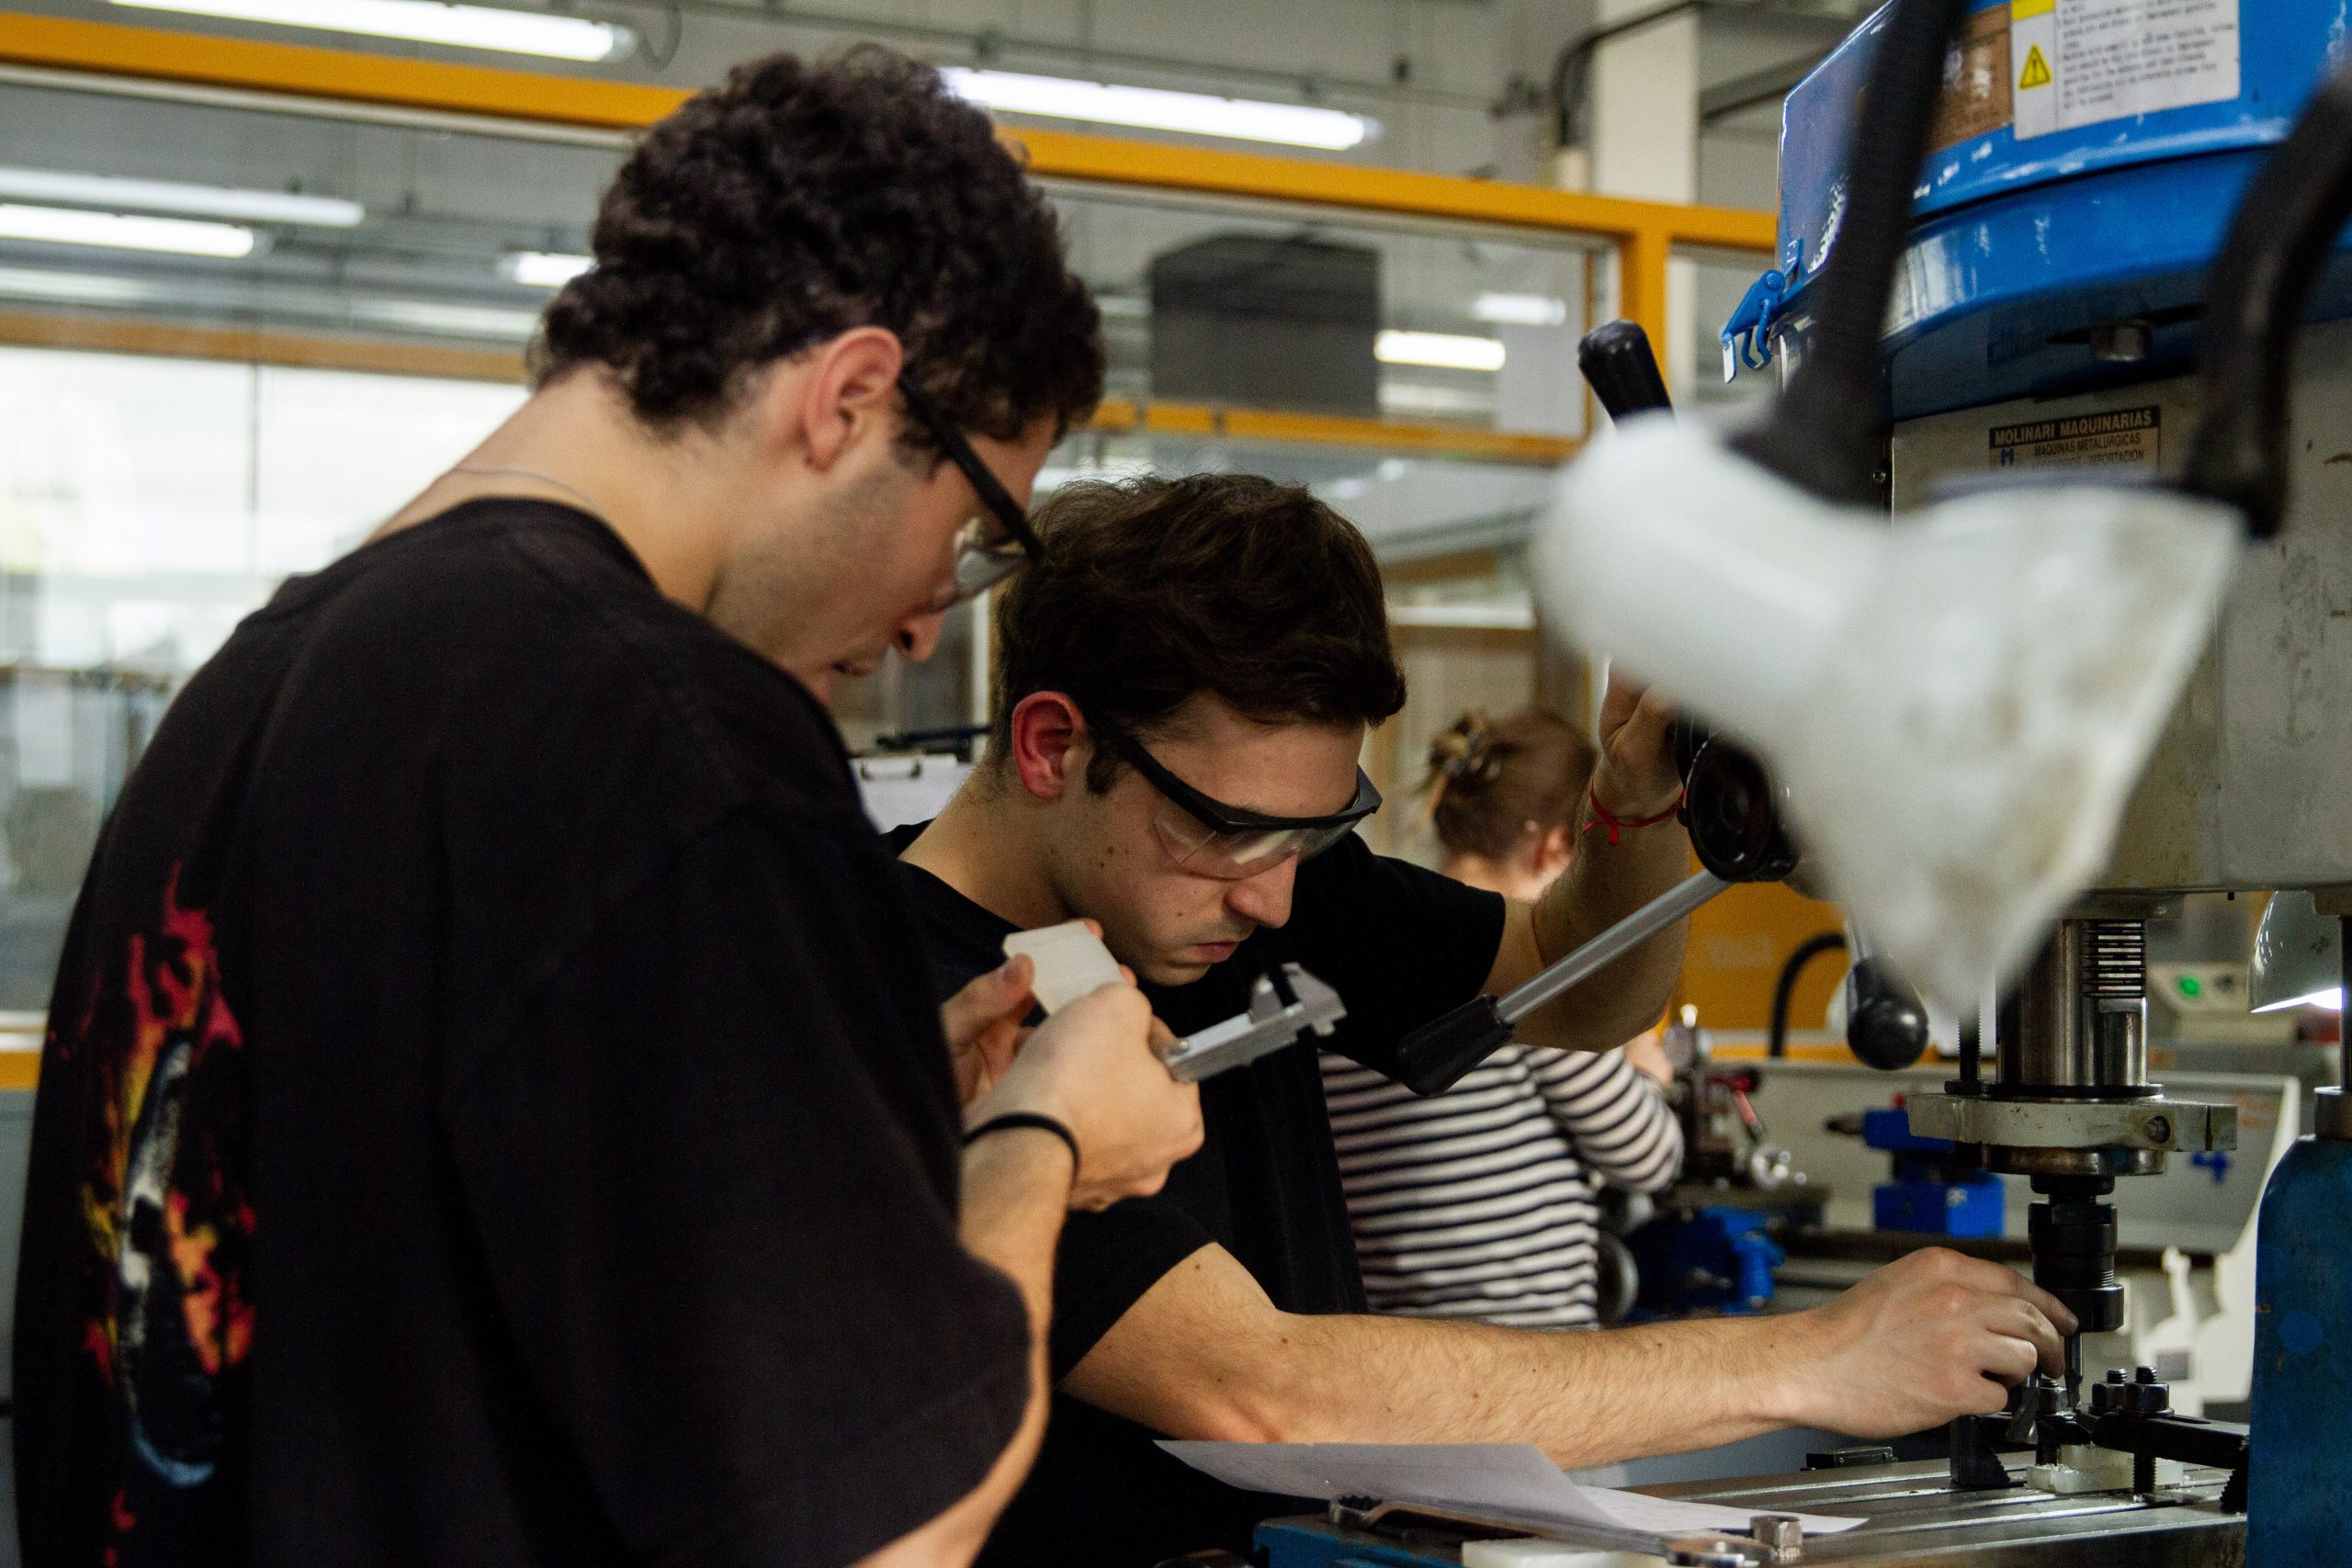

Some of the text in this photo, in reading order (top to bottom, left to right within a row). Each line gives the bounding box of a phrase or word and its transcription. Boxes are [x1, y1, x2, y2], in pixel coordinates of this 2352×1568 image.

[1995, 410, 2152, 446] MOLINARI MAQUINARIAS
[2034, 432, 2141, 457] MAQUINAS METALURGICAS
